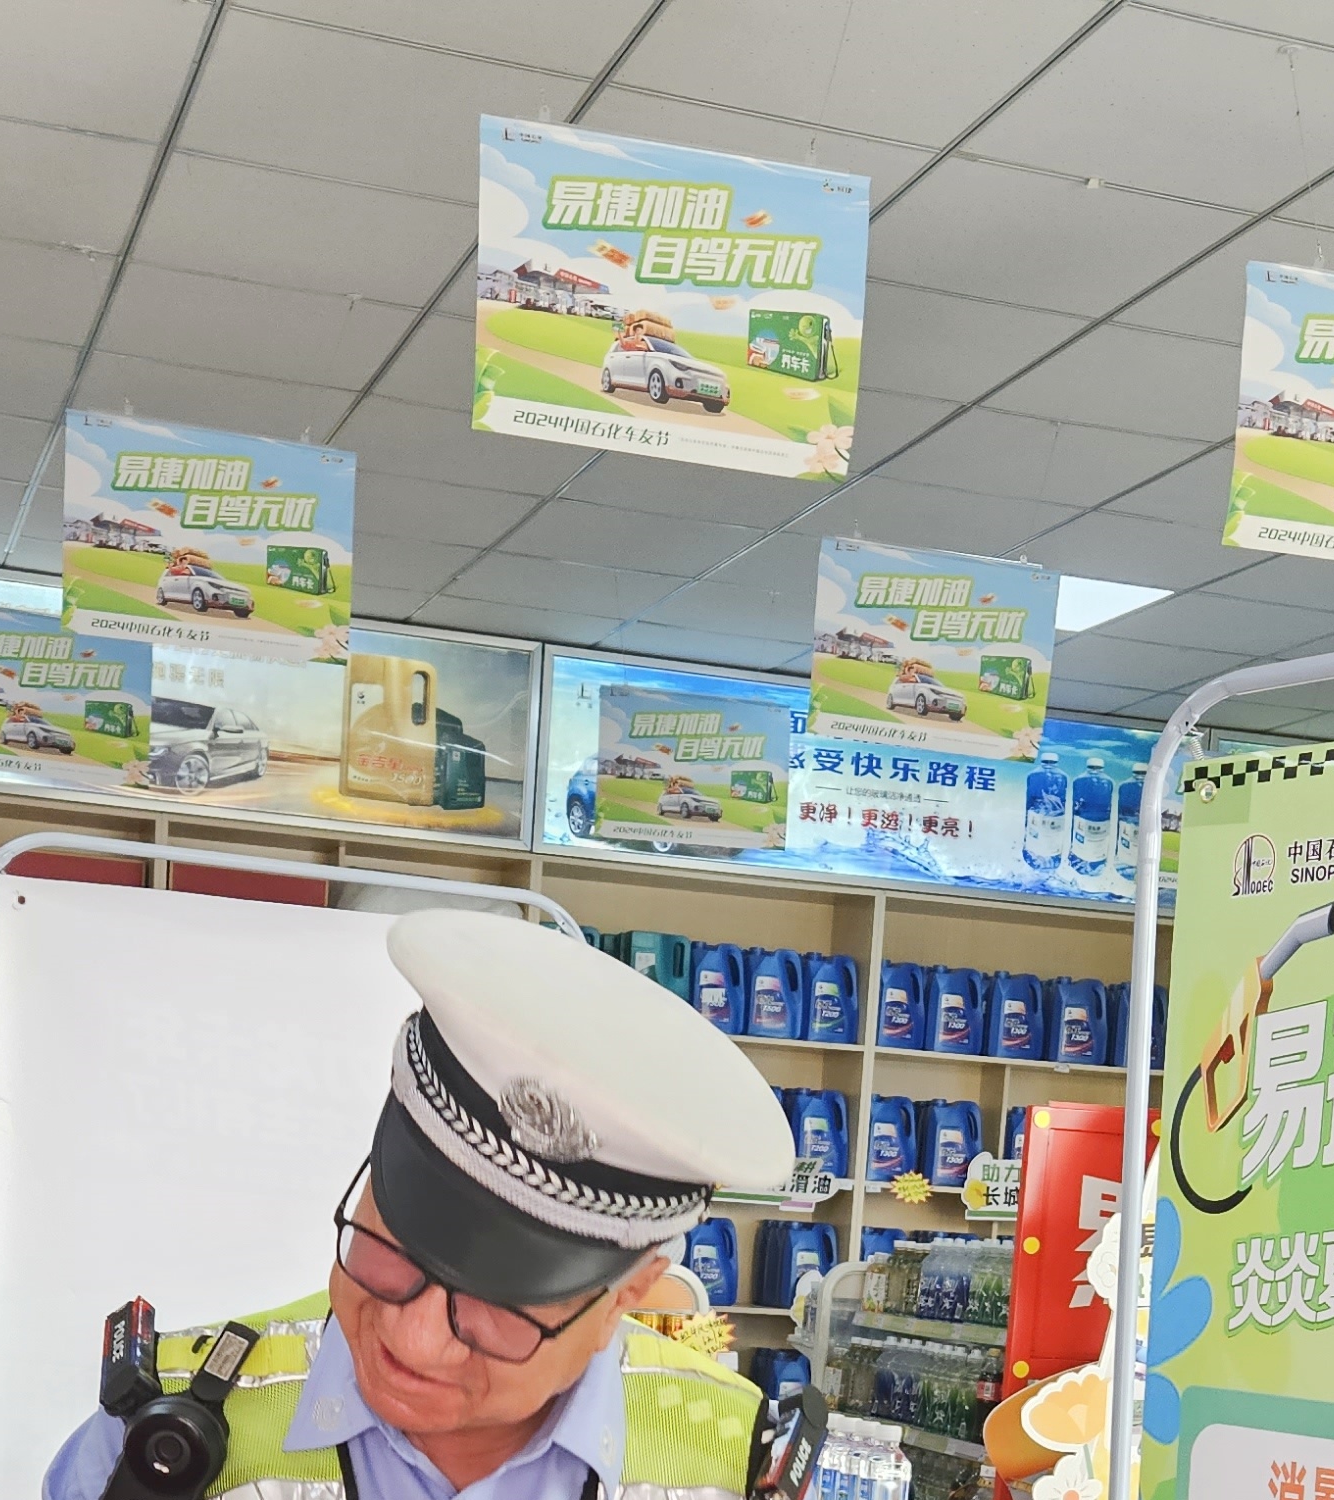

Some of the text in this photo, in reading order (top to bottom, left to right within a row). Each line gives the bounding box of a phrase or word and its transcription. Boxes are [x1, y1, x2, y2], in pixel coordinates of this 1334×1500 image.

[546, 181, 730, 231] 易捷加油
[639, 234, 817, 286] 自驾无忧
[513, 409, 671, 447] 2024中国石化车友节
[115, 455, 250, 490] 易捷加油
[183, 494, 317, 529] 自驾无忧
[857, 576, 972, 608] 易捷加油
[912, 610, 1027, 641] 自驾无忧
[21, 661, 125, 688] 自驾无忧
[631, 712, 721, 737] 易捷加油
[676, 736, 765, 761] 自驾无忧
[789, 1435, 813, 1488] POLICE
